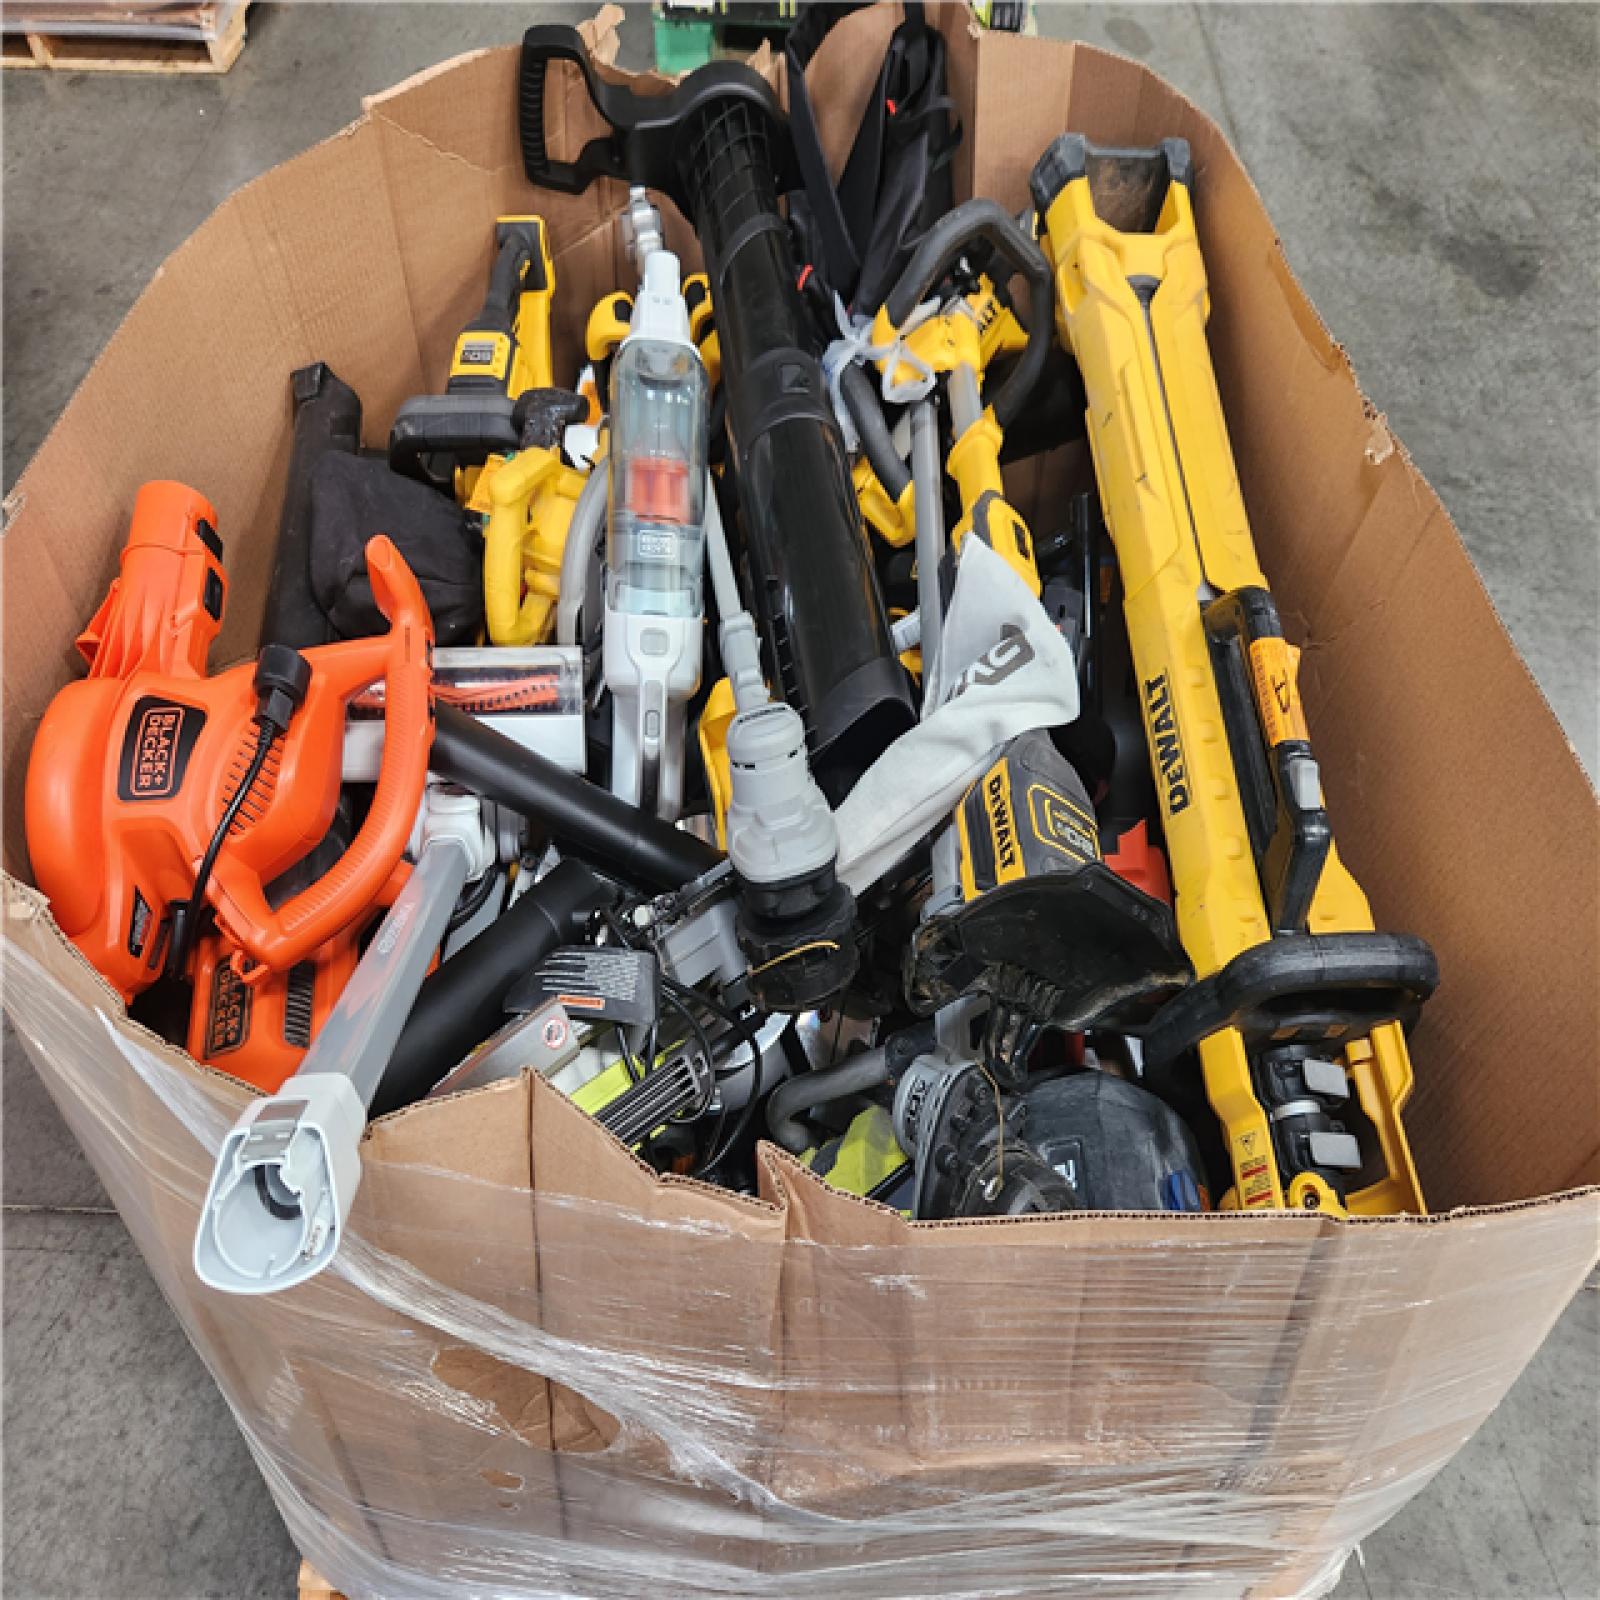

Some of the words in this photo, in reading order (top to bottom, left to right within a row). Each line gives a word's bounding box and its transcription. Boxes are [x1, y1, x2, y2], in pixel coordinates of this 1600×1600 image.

[139, 713, 161, 788] DECKER
[1144, 673, 1190, 816] DEWALT
[988, 774, 1016, 870] DEWALT
